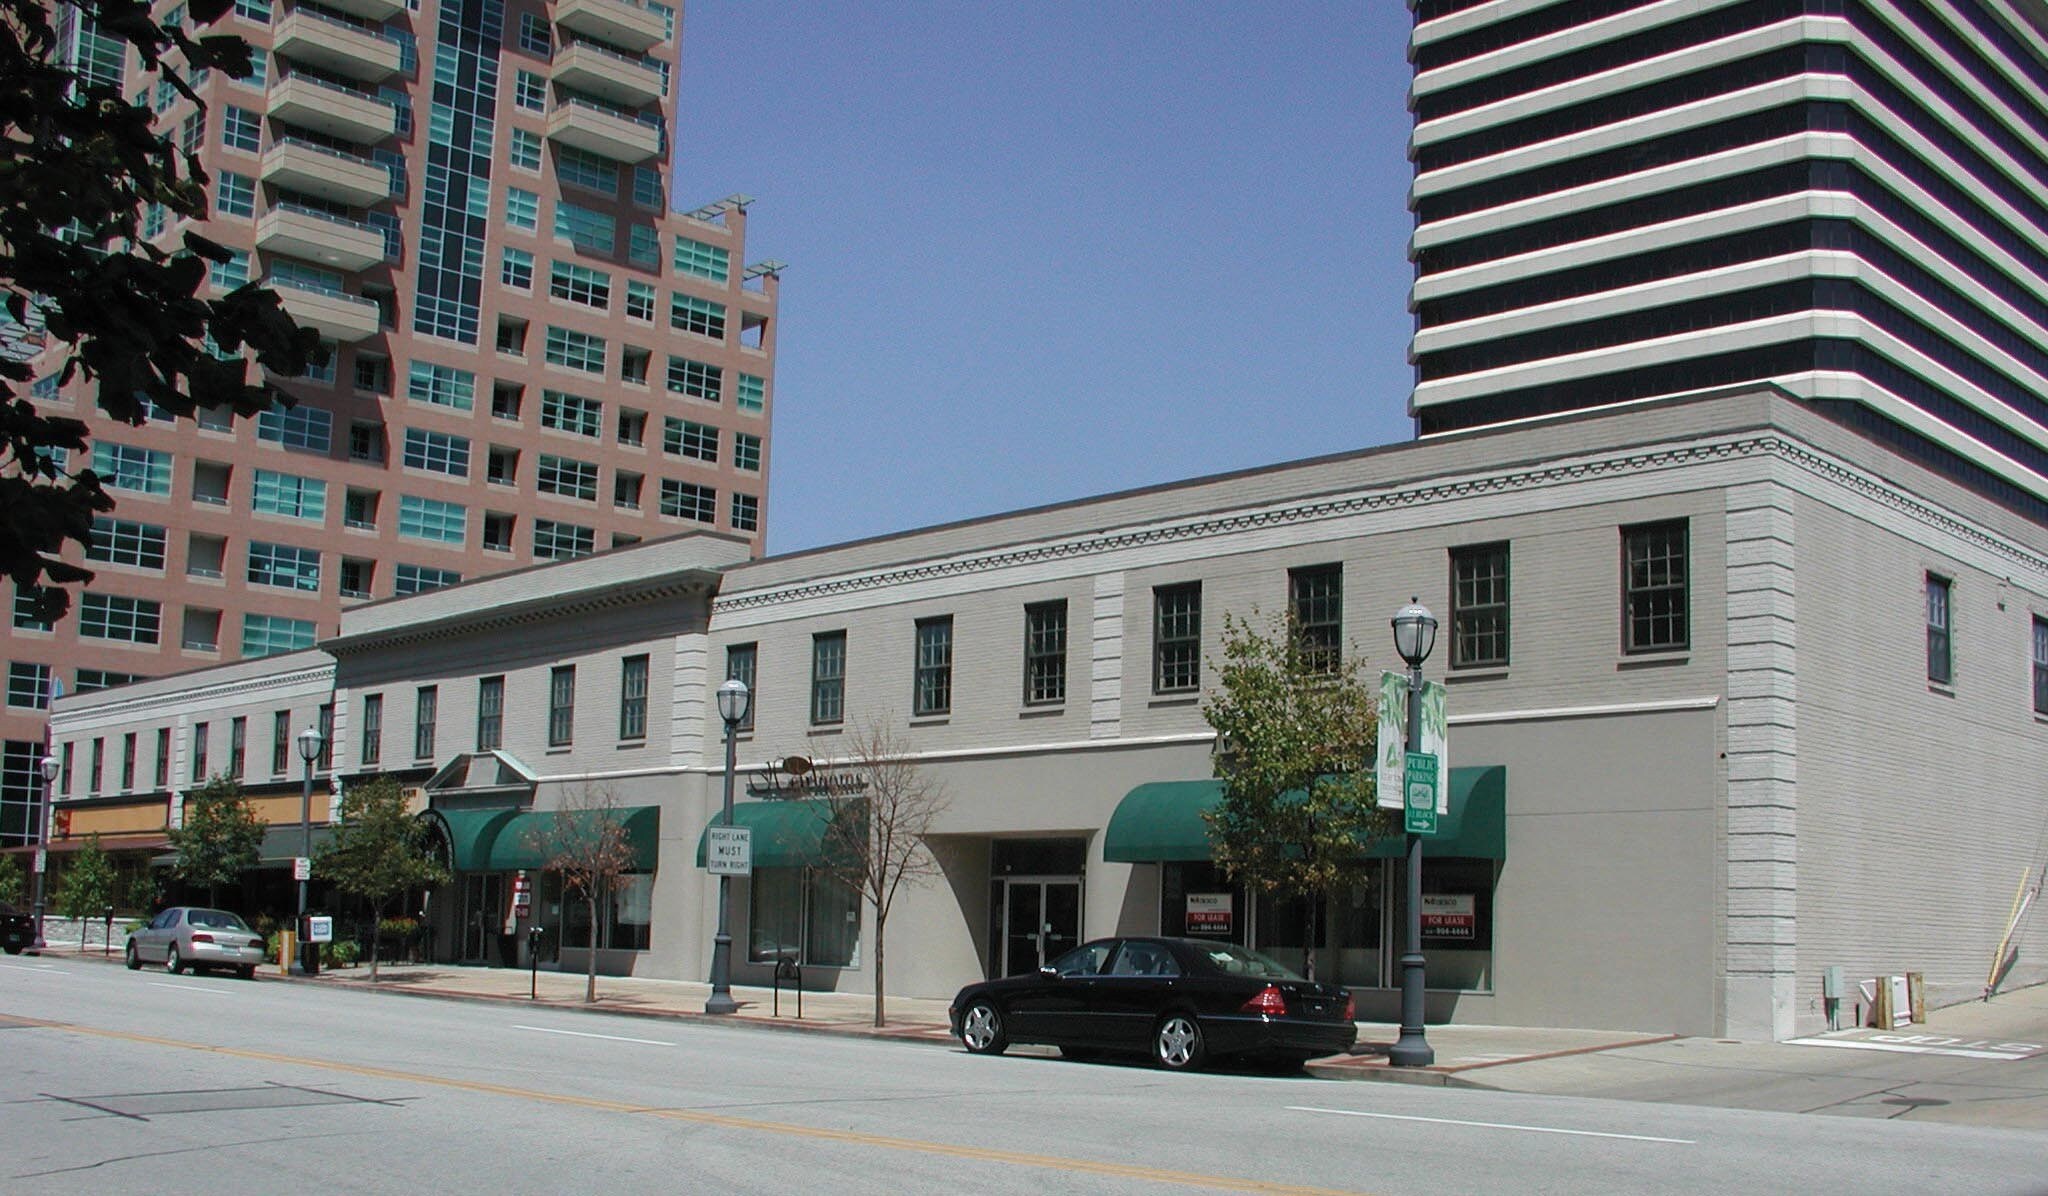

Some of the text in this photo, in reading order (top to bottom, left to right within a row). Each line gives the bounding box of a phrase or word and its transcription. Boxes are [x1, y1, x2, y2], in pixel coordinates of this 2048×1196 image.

[1407, 757, 1436, 770] PUBLIC
[1407, 770, 1434, 782] PARKING
[711, 832, 749, 842] RIGHT LANE
[718, 846, 741, 856] MUST
[710, 861, 748, 869] TURN RIGHT
[1193, 913, 1224, 922] FOR LEASE
[1428, 916, 1464, 925] FOR LEASE
[1868, 1035, 2042, 1051] STOP
